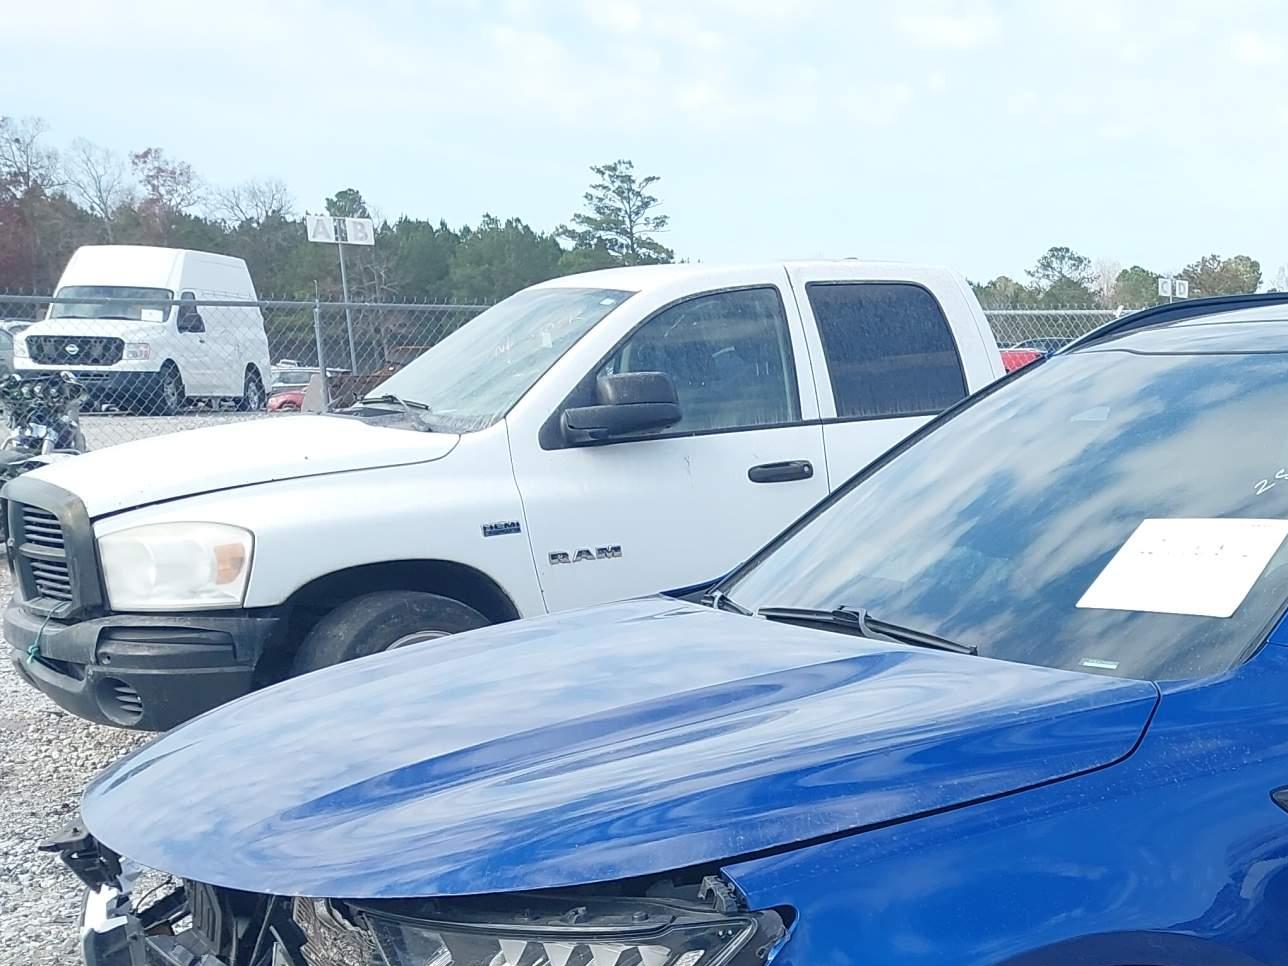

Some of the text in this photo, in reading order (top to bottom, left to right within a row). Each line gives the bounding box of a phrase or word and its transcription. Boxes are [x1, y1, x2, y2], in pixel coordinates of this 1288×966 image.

[312, 219, 368, 241] A B
[482, 521, 521, 531] HEMI
[548, 545, 622, 565] RAM
